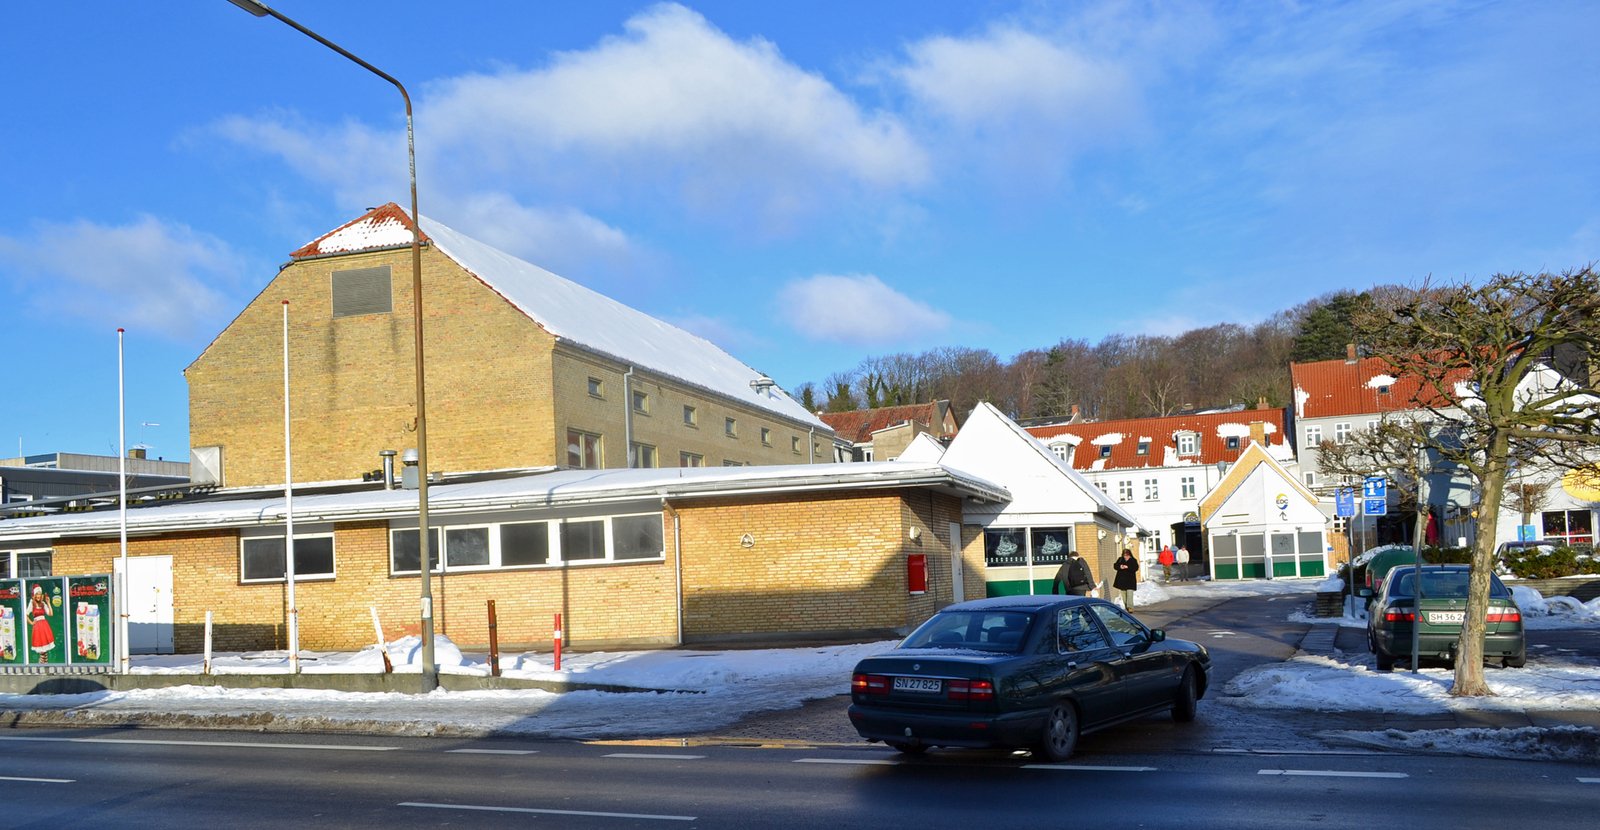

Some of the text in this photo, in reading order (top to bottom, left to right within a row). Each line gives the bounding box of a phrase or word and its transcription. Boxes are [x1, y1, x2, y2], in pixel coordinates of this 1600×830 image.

[1430, 613, 1443, 621] SH
[1444, 613, 1456, 621] 36
[909, 679, 921, 689] 27
[922, 679, 940, 691] 825
